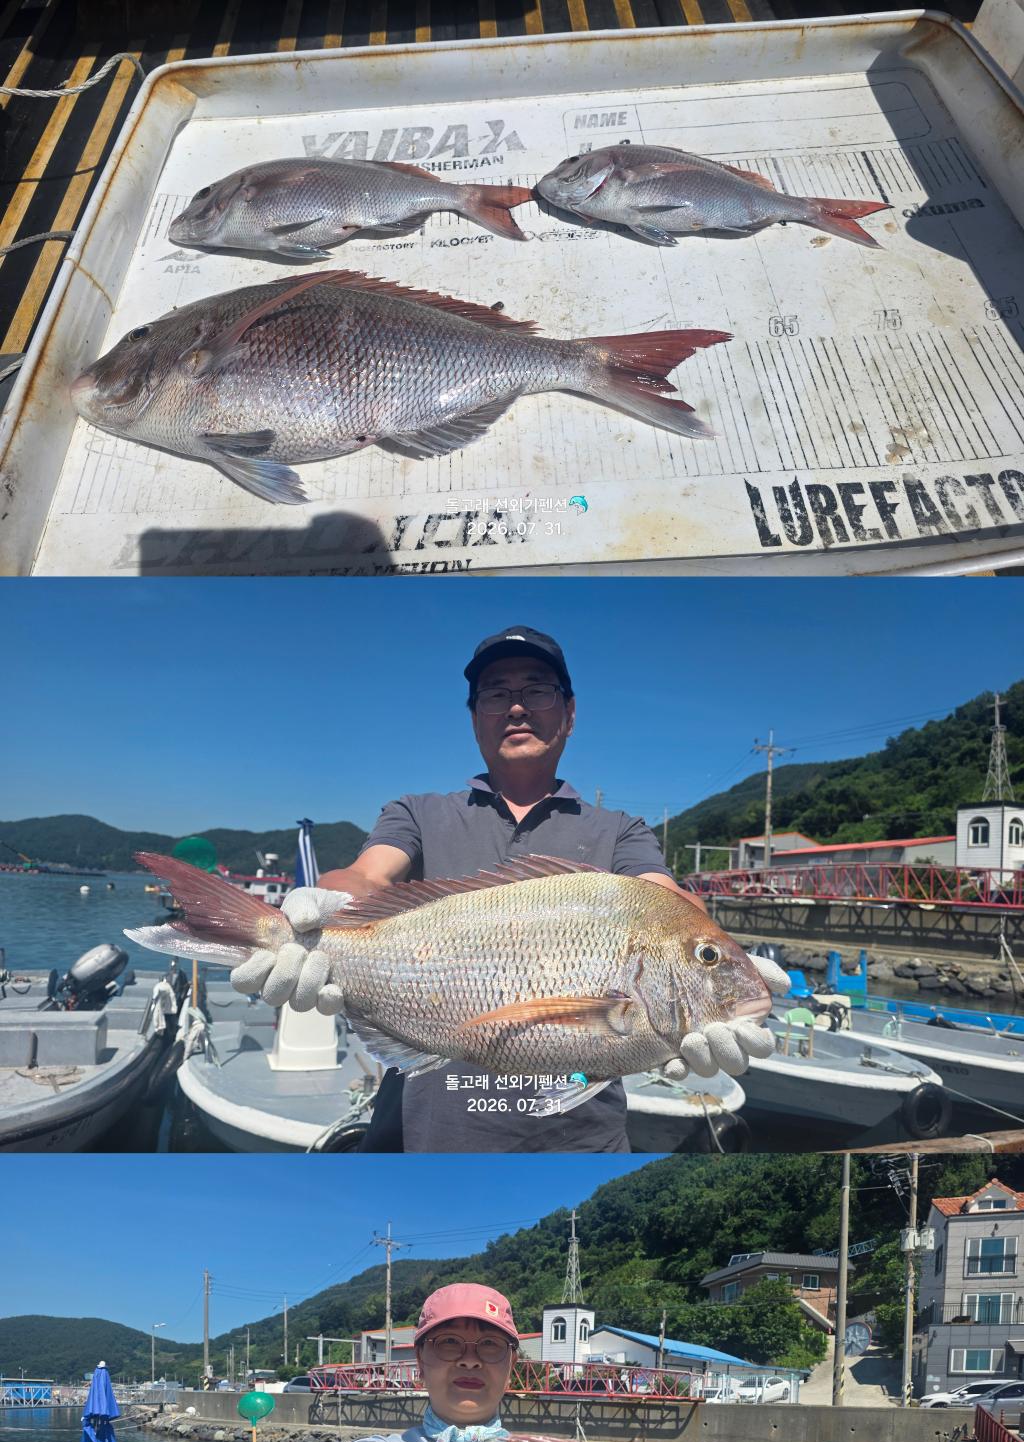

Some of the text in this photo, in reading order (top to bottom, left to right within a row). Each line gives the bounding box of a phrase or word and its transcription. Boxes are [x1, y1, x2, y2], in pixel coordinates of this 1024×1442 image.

[574, 111, 627, 129] NAME
[419, 155, 503, 172] SHERMAN
[162, 264, 201, 274] APIA
[984, 296, 1019, 321] 85
[768, 315, 799, 338] 65
[873, 308, 903, 332] 75
